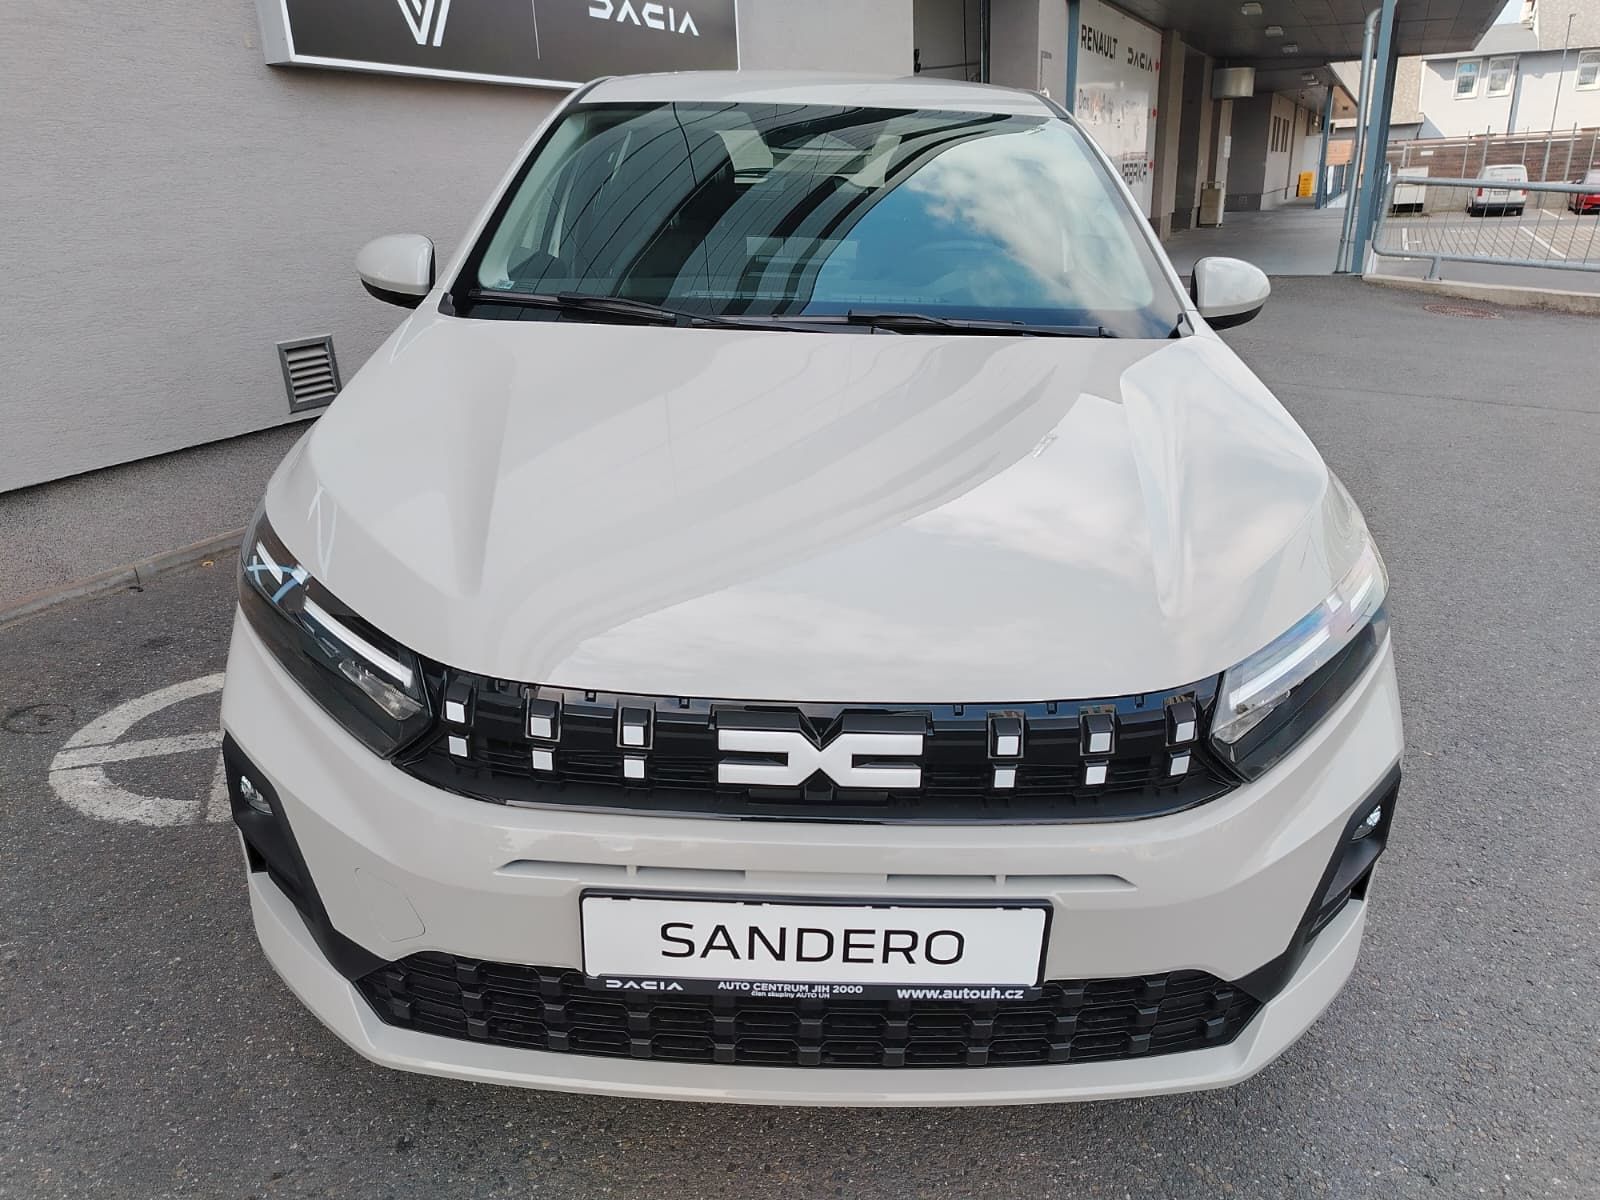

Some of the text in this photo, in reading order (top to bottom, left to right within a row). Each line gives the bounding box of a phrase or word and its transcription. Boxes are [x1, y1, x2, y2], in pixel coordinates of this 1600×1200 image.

[588, 0, 700, 36] DACIA
[1081, 24, 1118, 60] RENAULT
[1127, 46, 1153, 73] DACIA
[660, 922, 965, 965] SANDERO
[605, 979, 684, 991] DACIA
[717, 981, 863, 994] AUTO CENTRUM JIH 2000
[896, 987, 1025, 999] www.autouh.cz
